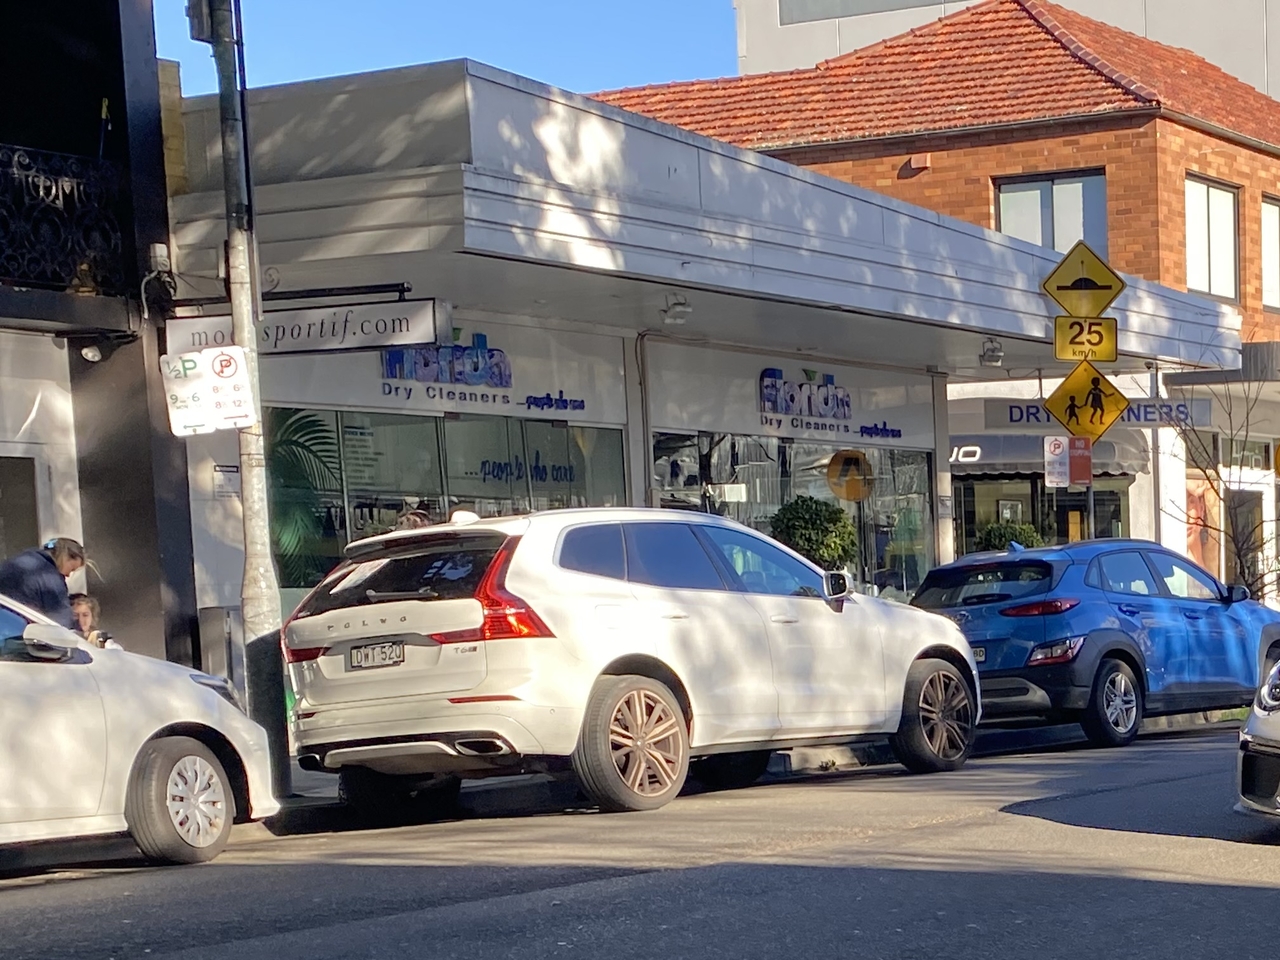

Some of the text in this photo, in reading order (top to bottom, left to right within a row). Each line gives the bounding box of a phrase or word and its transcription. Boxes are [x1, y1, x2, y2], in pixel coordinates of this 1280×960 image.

[190, 309, 412, 348] mosportif.com
[1069, 321, 1104, 347] 25
[1072, 348, 1097, 358] km/h
[382, 383, 412, 400] Dry
[426, 386, 510, 404] Cleaners
[1009, 404, 1189, 422] DRY NERS
[761, 414, 782, 429] Dry
[791, 417, 850, 433] Cleaners
[1075, 440, 1085, 448] NO
